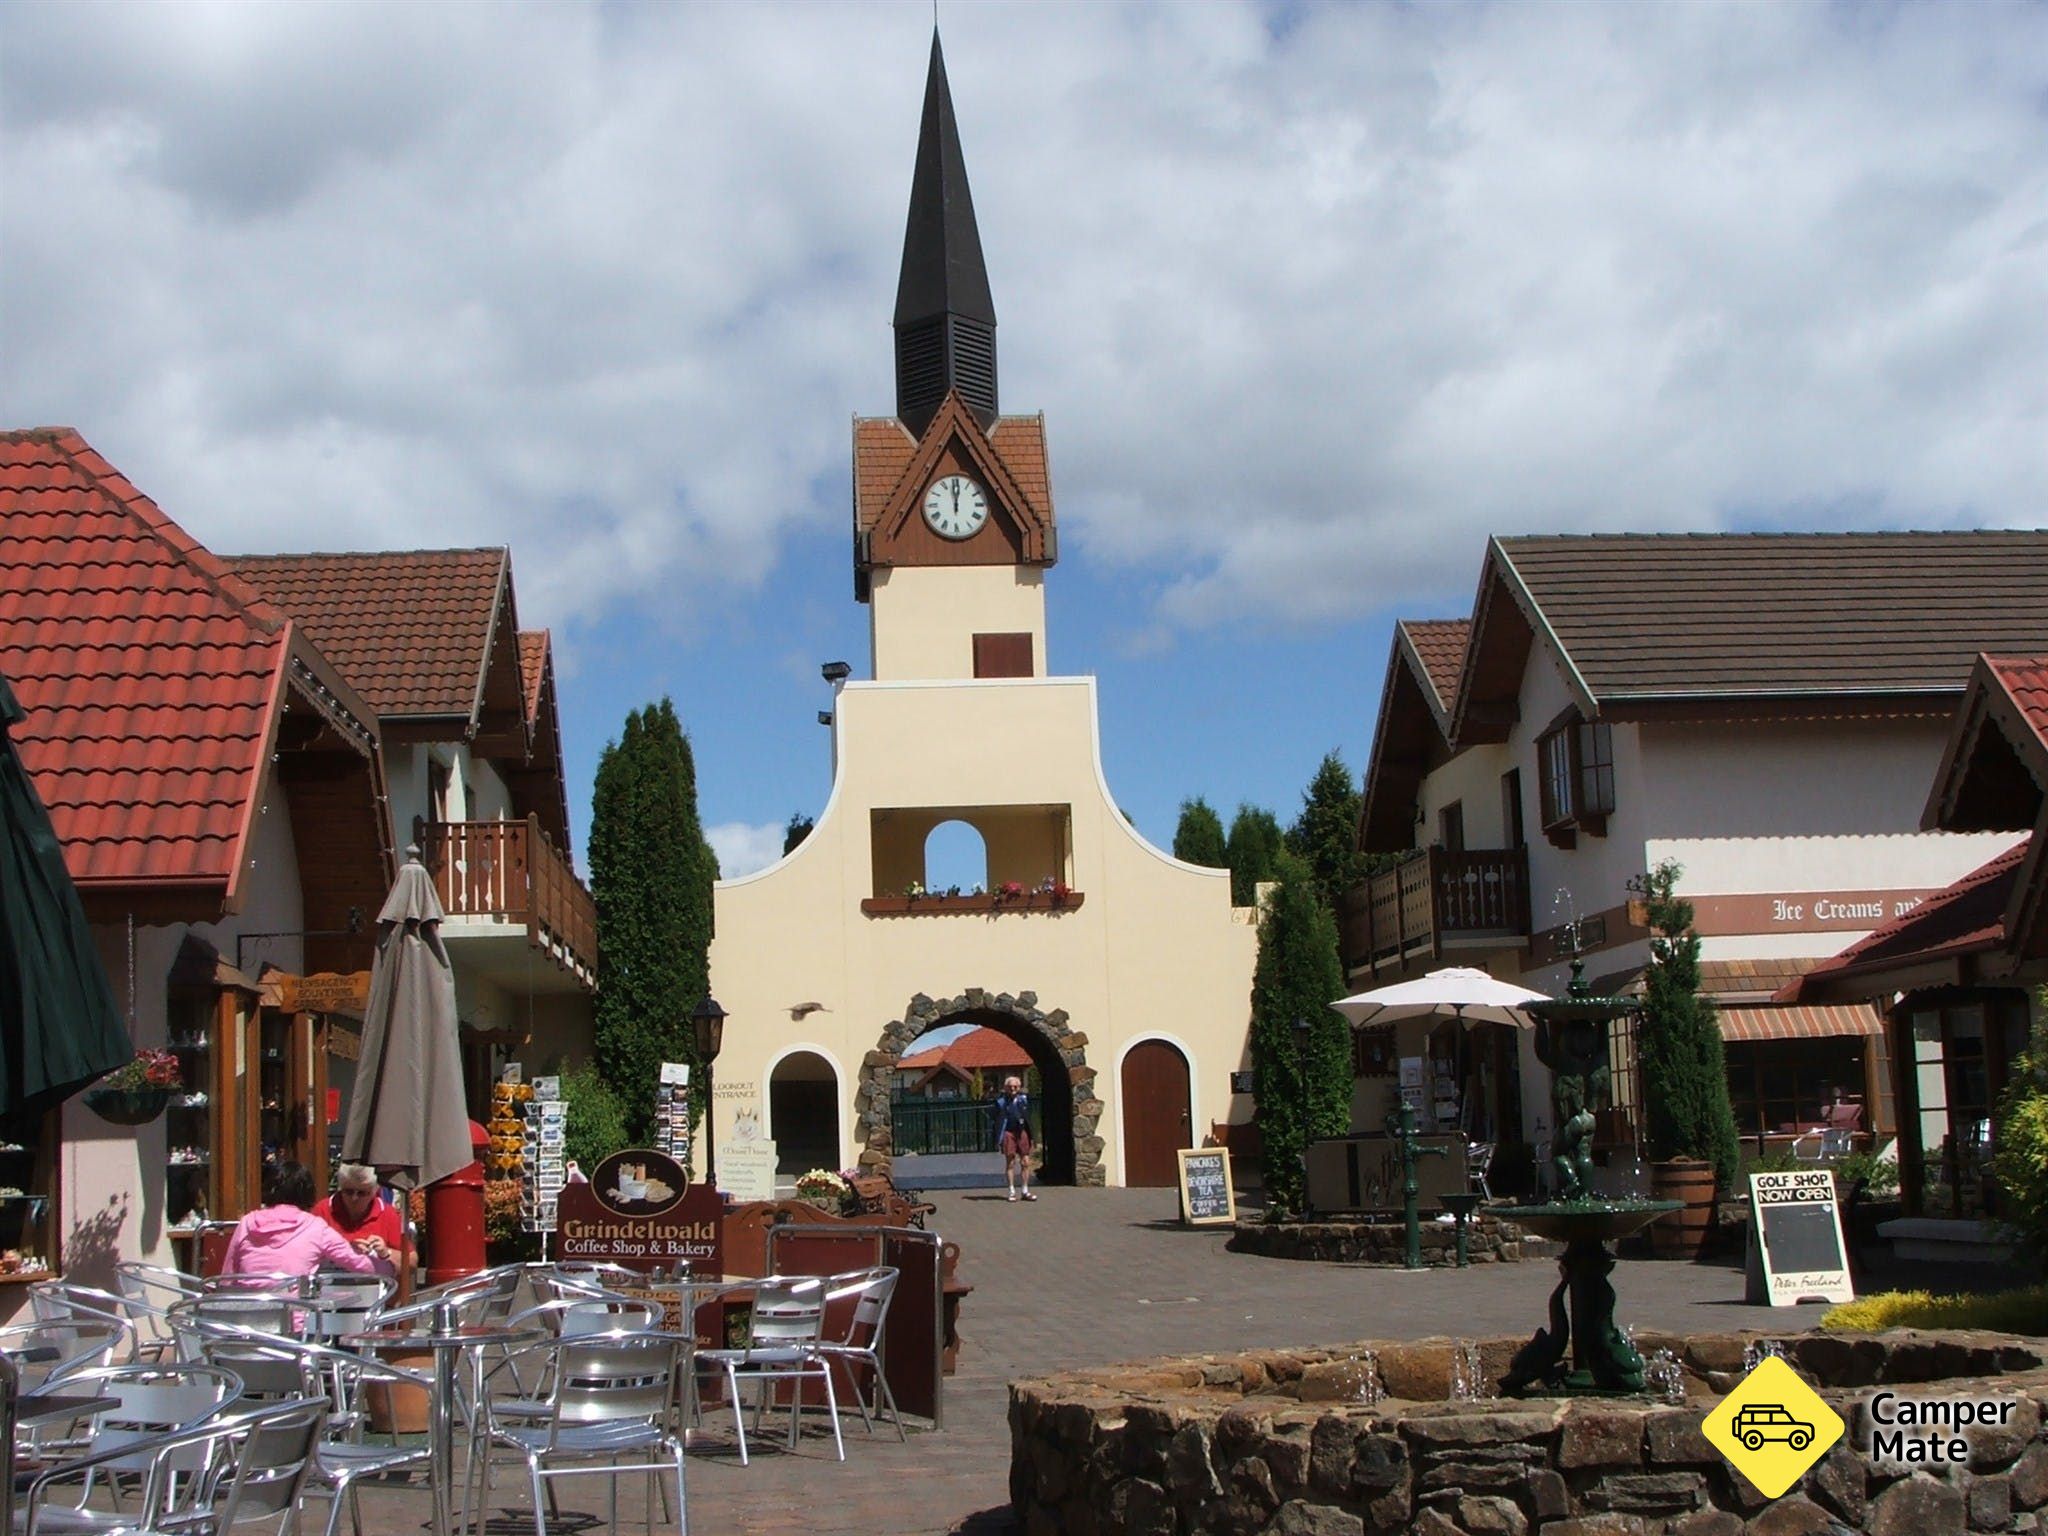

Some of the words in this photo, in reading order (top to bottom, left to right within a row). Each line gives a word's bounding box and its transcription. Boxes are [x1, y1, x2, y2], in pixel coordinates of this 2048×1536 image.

[1772, 899, 1803, 920] Ice
[1814, 899, 1883, 919] Creams
[713, 1090, 757, 1099] NTRANCE
[1757, 1176, 1789, 1188] GOLF
[1794, 1174, 1828, 1187] SHOP
[1758, 1190, 1793, 1202] NOW
[1796, 1188, 1832, 1200] OPEN
[564, 1219, 715, 1241] Grindelwald
[564, 1239, 608, 1254] Coffee
[612, 1240, 645, 1256] Shop
[650, 1240, 662, 1254] &
[667, 1241, 716, 1258] Bakery
